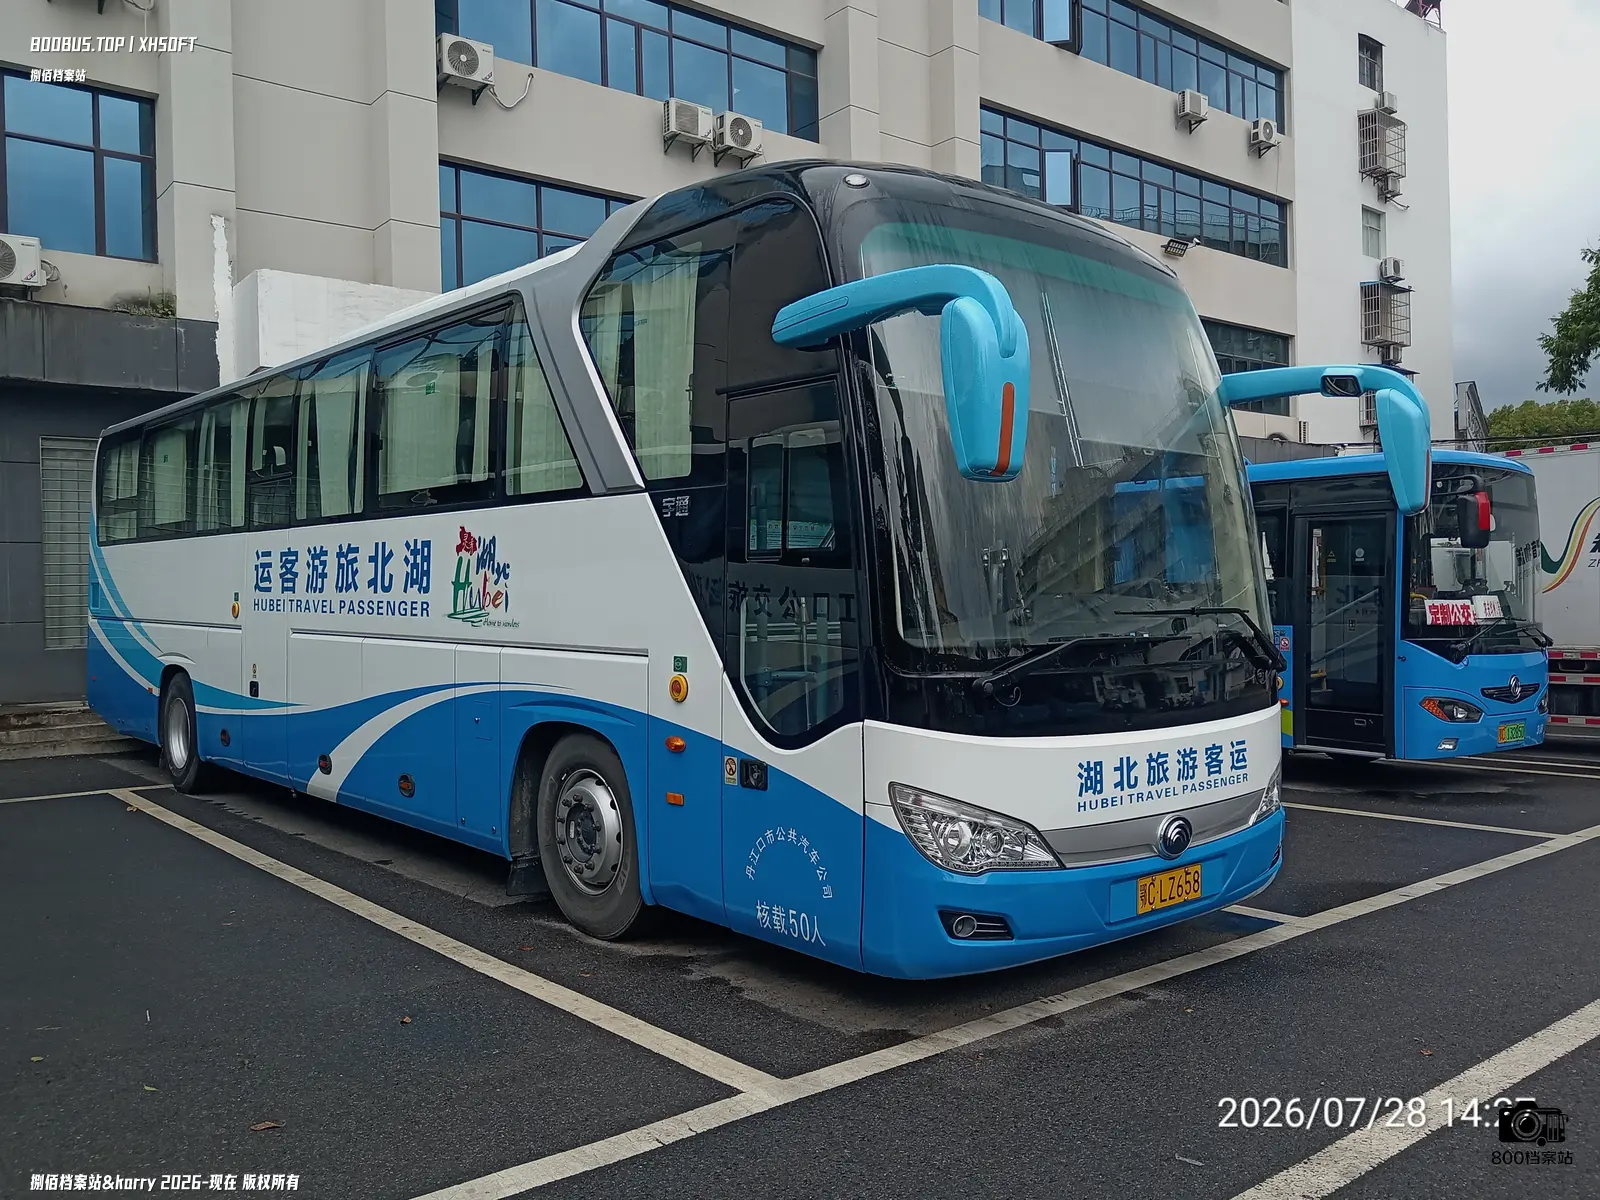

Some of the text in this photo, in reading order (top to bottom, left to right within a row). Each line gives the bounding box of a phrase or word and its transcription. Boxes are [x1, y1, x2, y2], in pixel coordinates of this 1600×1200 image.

[253, 598, 431, 617] HUBEI TRAVEL PASSENGER
[1077, 740, 1248, 798] 湖北旅游客运
[1077, 773, 1249, 812] HUBEI TRAVEL PASSENGER
[745, 826, 833, 899] 丹江口市公共汽车公司
[756, 900, 827, 947] 核载50人
